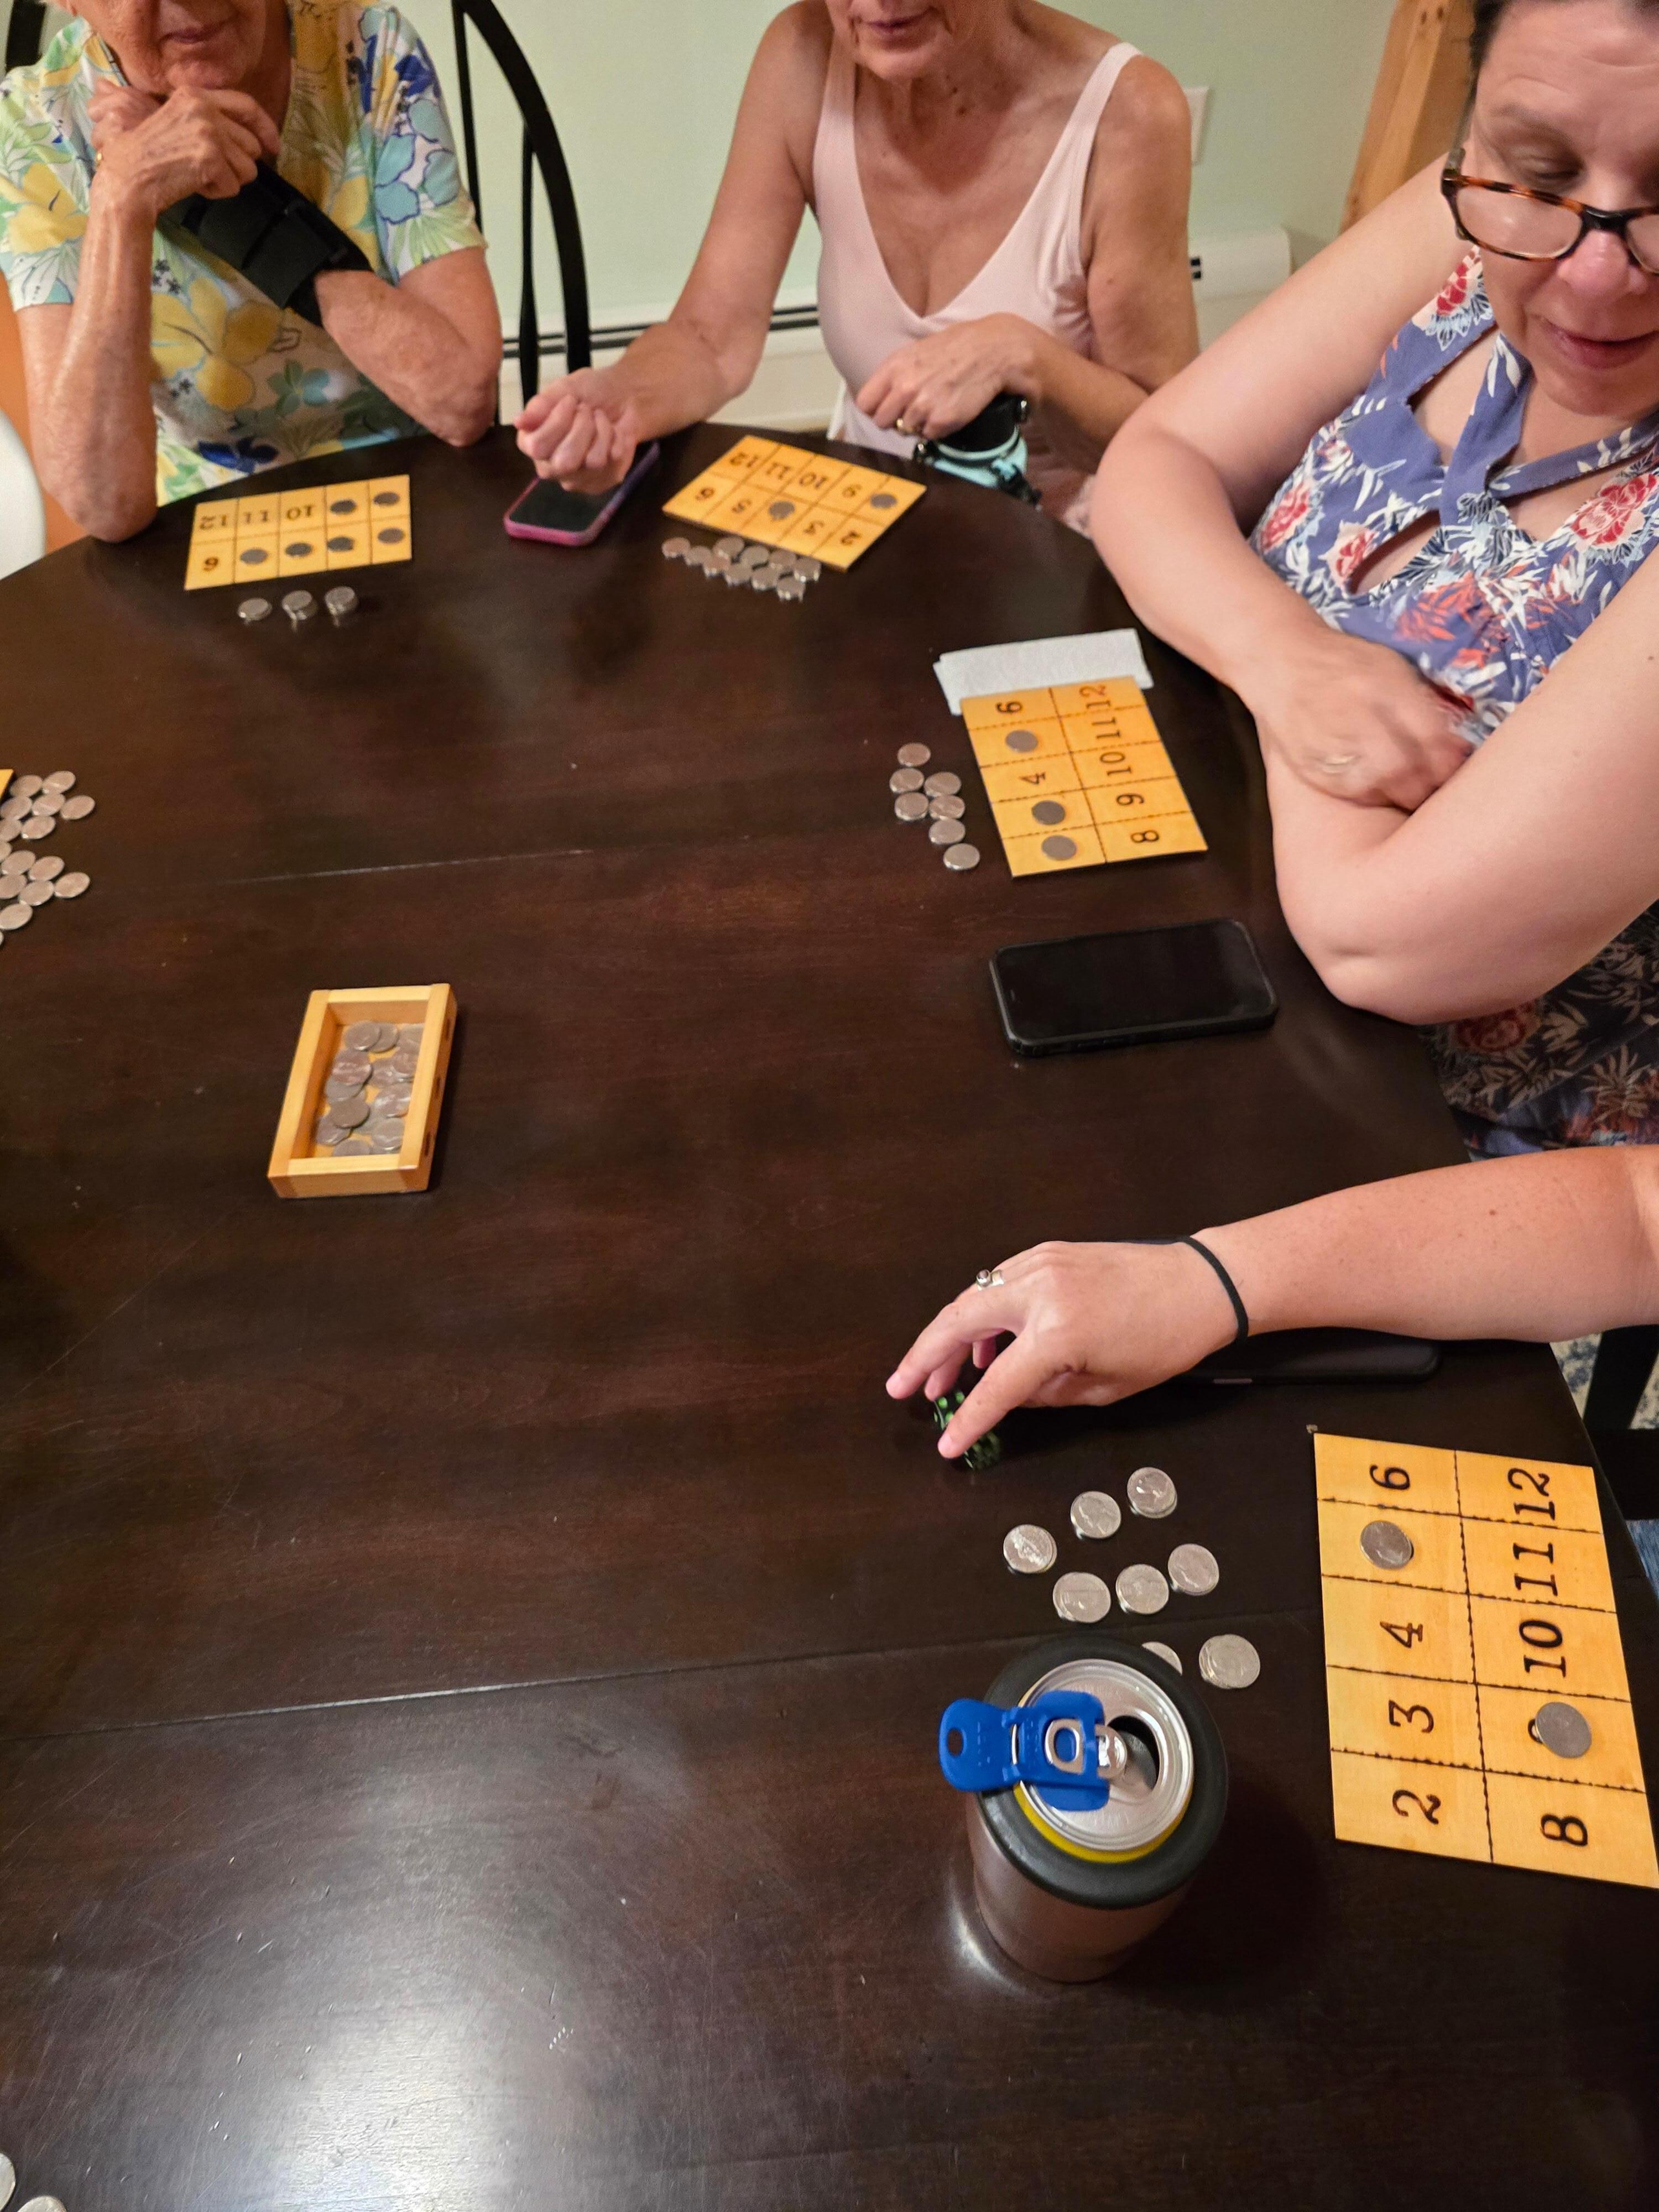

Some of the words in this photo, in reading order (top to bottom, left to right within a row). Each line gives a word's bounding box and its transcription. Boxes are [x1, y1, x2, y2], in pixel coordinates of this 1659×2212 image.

[729, 452, 759, 468] 12
[765, 462, 791, 479] 11
[799, 472, 827, 489] 10
[244, 509, 269, 524] 11
[286, 503, 316, 520] 10
[200, 514, 227, 530] 12
[841, 530, 862, 546] 2
[1079, 685, 1111, 709] 12
[995, 701, 1023, 714] 6
[1092, 717, 1121, 740] 11
[1099, 751, 1132, 776] 10
[1019, 771, 1046, 785] 4
[1115, 792, 1145, 806] 9
[1130, 830, 1160, 843] 8
[1369, 1464, 1411, 1491] 6
[1507, 1467, 1556, 1521] 12
[1512, 1541, 1558, 1597] 11
[1379, 1620, 1423, 1649] 4
[1519, 1619, 1567, 1678] 10
[1387, 1699, 1434, 1734] 3
[1392, 1788, 1442, 1825] 2
[1539, 1812, 1589, 1847] 8
